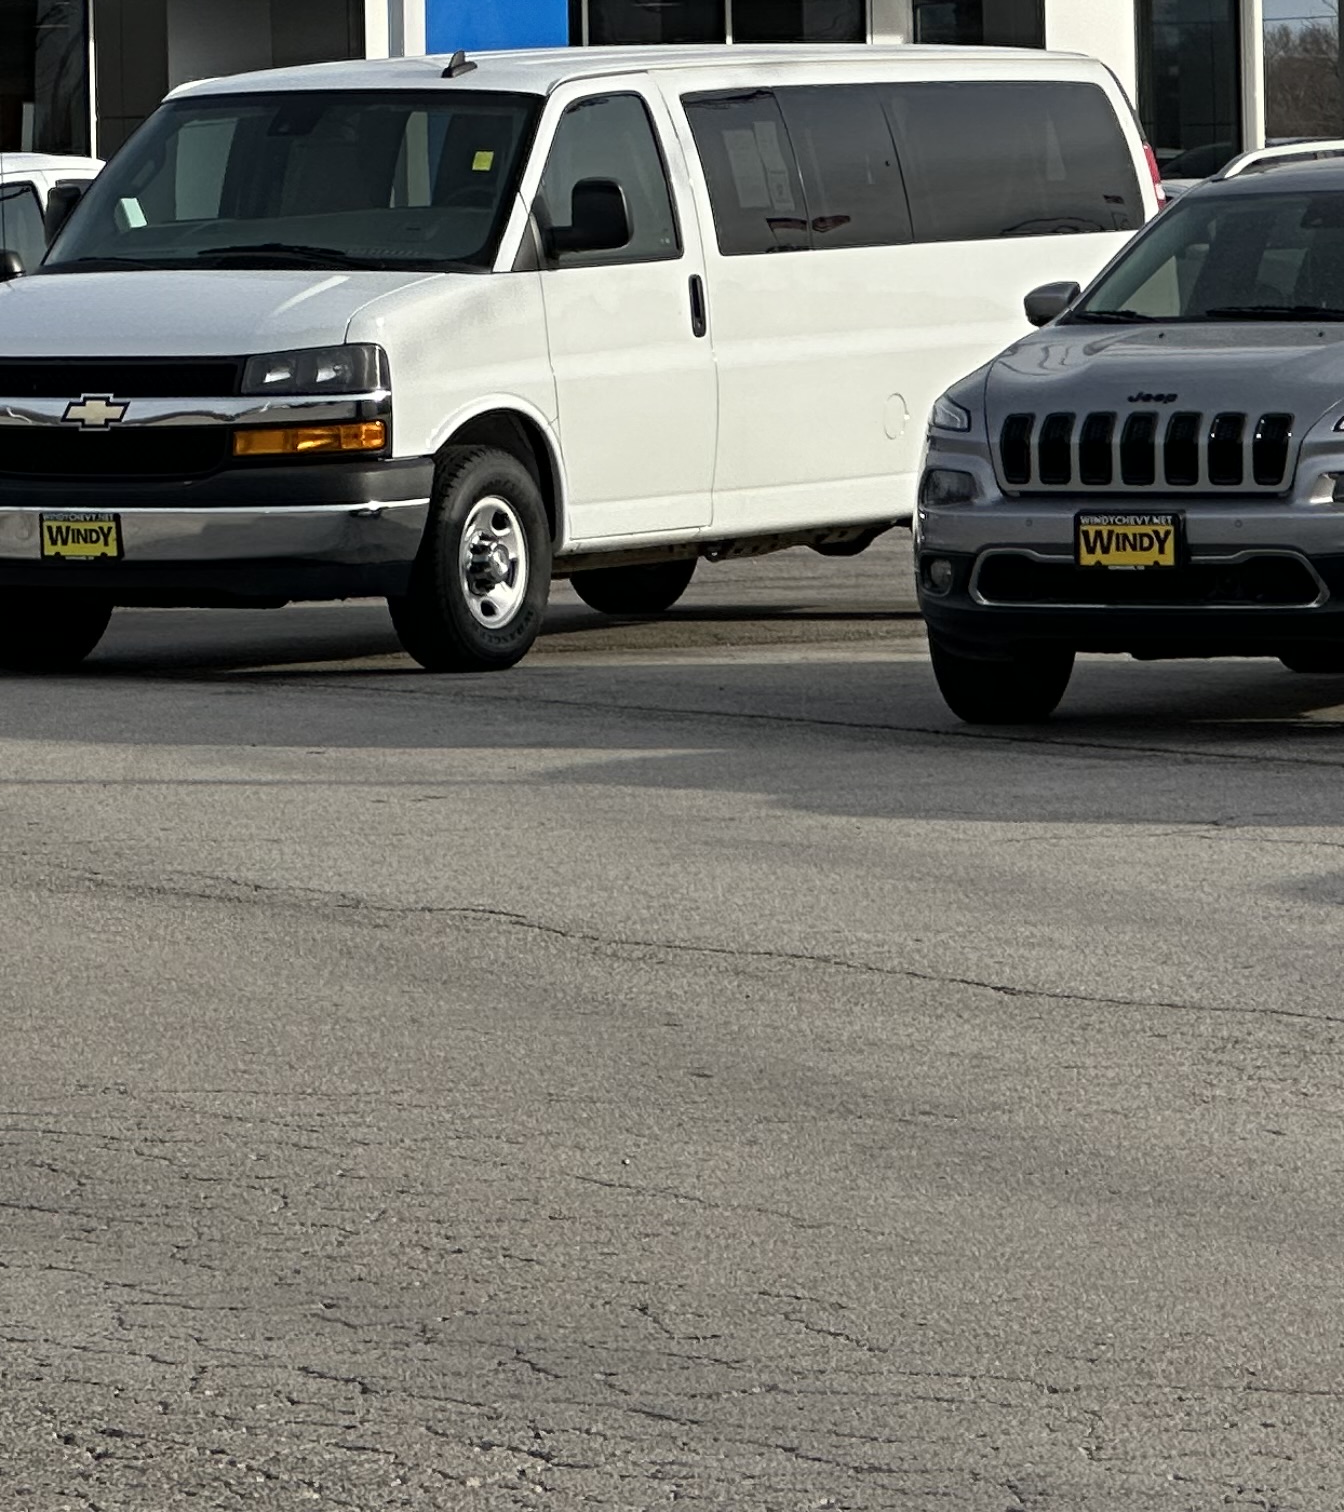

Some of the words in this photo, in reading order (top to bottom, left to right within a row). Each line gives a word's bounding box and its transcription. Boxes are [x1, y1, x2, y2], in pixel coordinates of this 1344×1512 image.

[1080, 515, 1172, 525] WINDYCHEVY.NET
[46, 525, 113, 547] WINDY
[1081, 529, 1172, 555] WINDY
